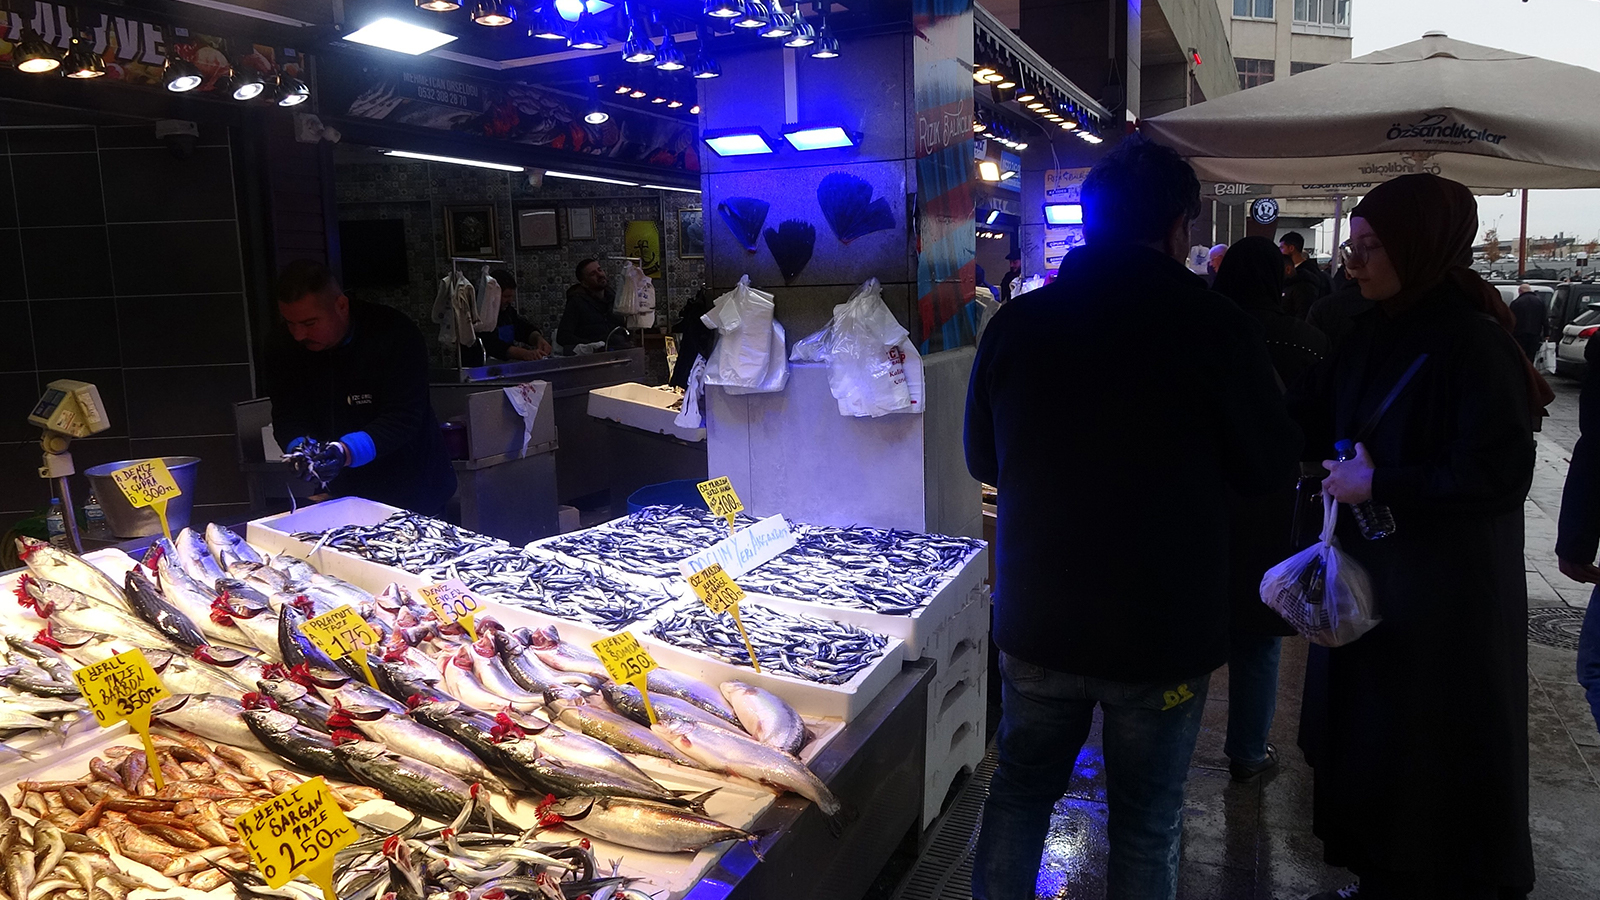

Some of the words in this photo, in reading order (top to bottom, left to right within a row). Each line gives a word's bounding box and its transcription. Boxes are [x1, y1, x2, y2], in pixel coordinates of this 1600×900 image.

[691, 576, 702, 587] ÖZ
[310, 607, 353, 631] PALAMUT
[442, 595, 477, 622] 300
[323, 619, 348, 634] TAZE
[331, 624, 372, 656] 175
[610, 639, 640, 661] SOMON
[99, 667, 145, 705] BARBON
[104, 664, 136, 688] TAZE
[269, 790, 323, 837] SARGAN
[293, 810, 328, 840] TAZE
[279, 828, 350, 873] 250TL
